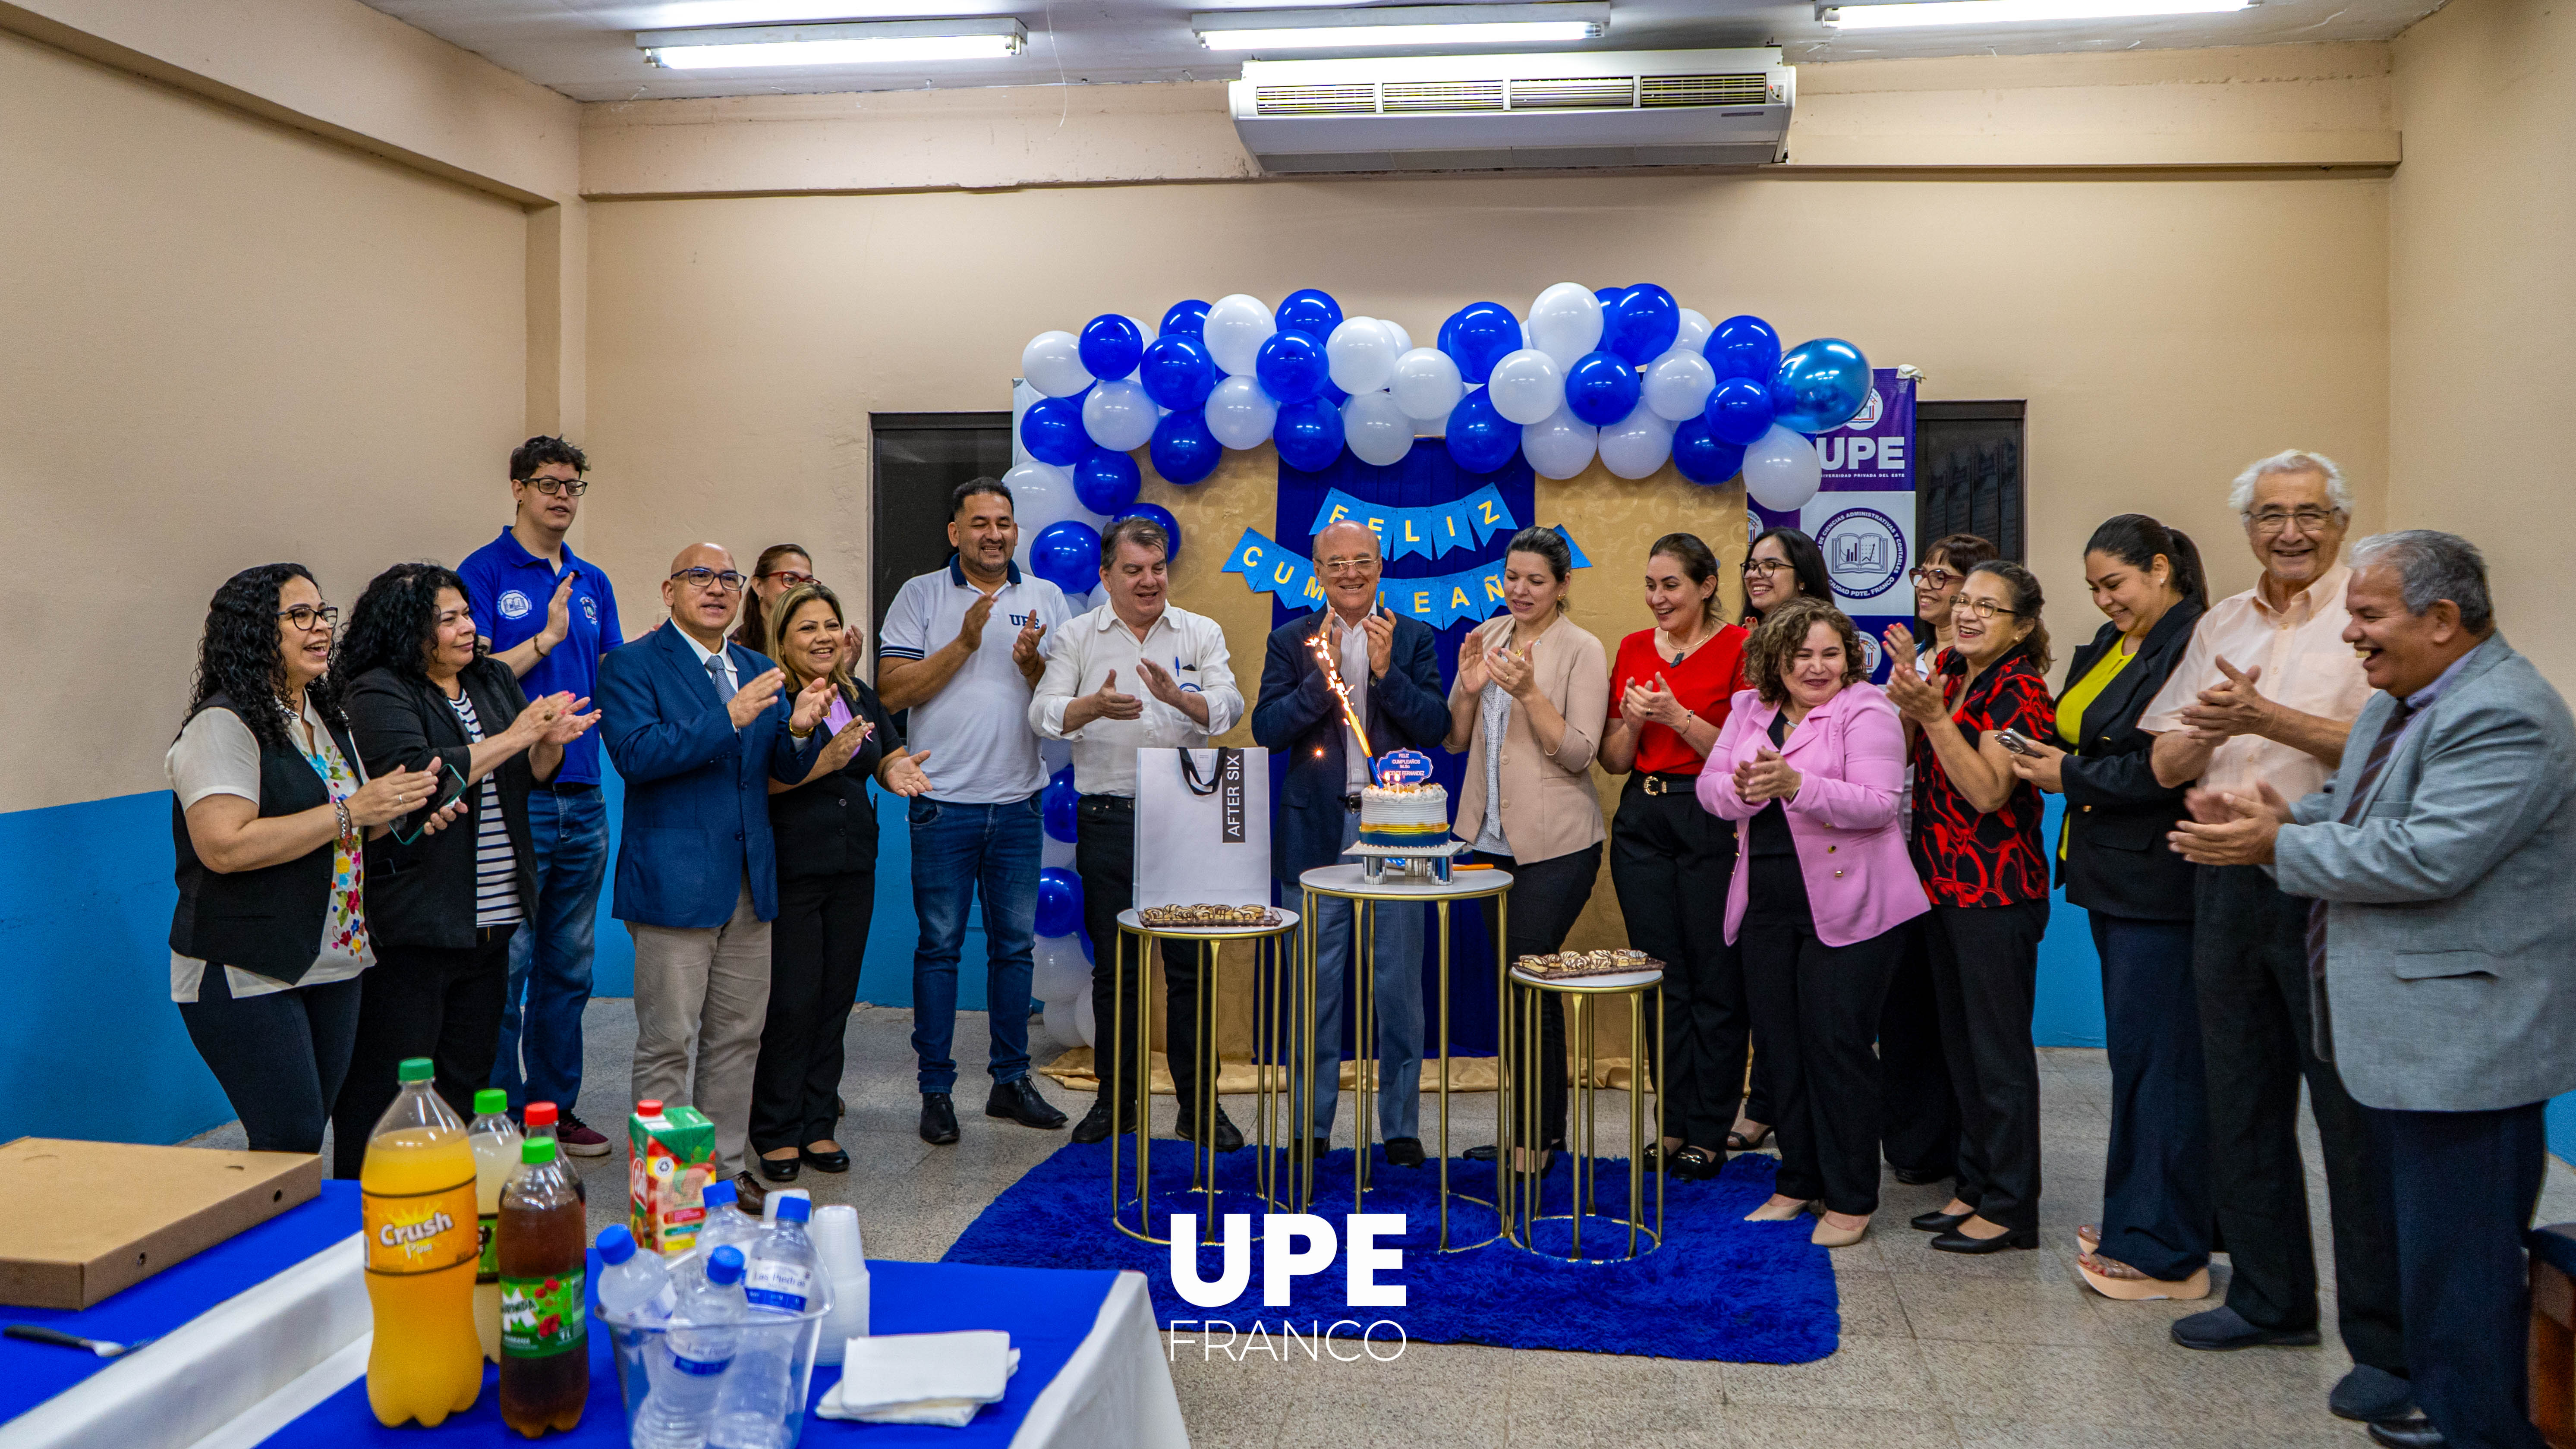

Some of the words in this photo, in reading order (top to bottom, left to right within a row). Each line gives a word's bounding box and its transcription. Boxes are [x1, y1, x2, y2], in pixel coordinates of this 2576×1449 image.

[1816, 437, 1905, 470] UPE
[1822, 515, 1845, 535] CIENCIAS
[1846, 511, 1896, 534] ADMINISTRATIVAS
[1894, 539, 1903, 573] CONTABLES
[1871, 576, 1895, 595] FRANCO
[1227, 755, 1240, 780] SIX
[1227, 786, 1240, 837] AFTER
[380, 1212, 454, 1246] Crush
